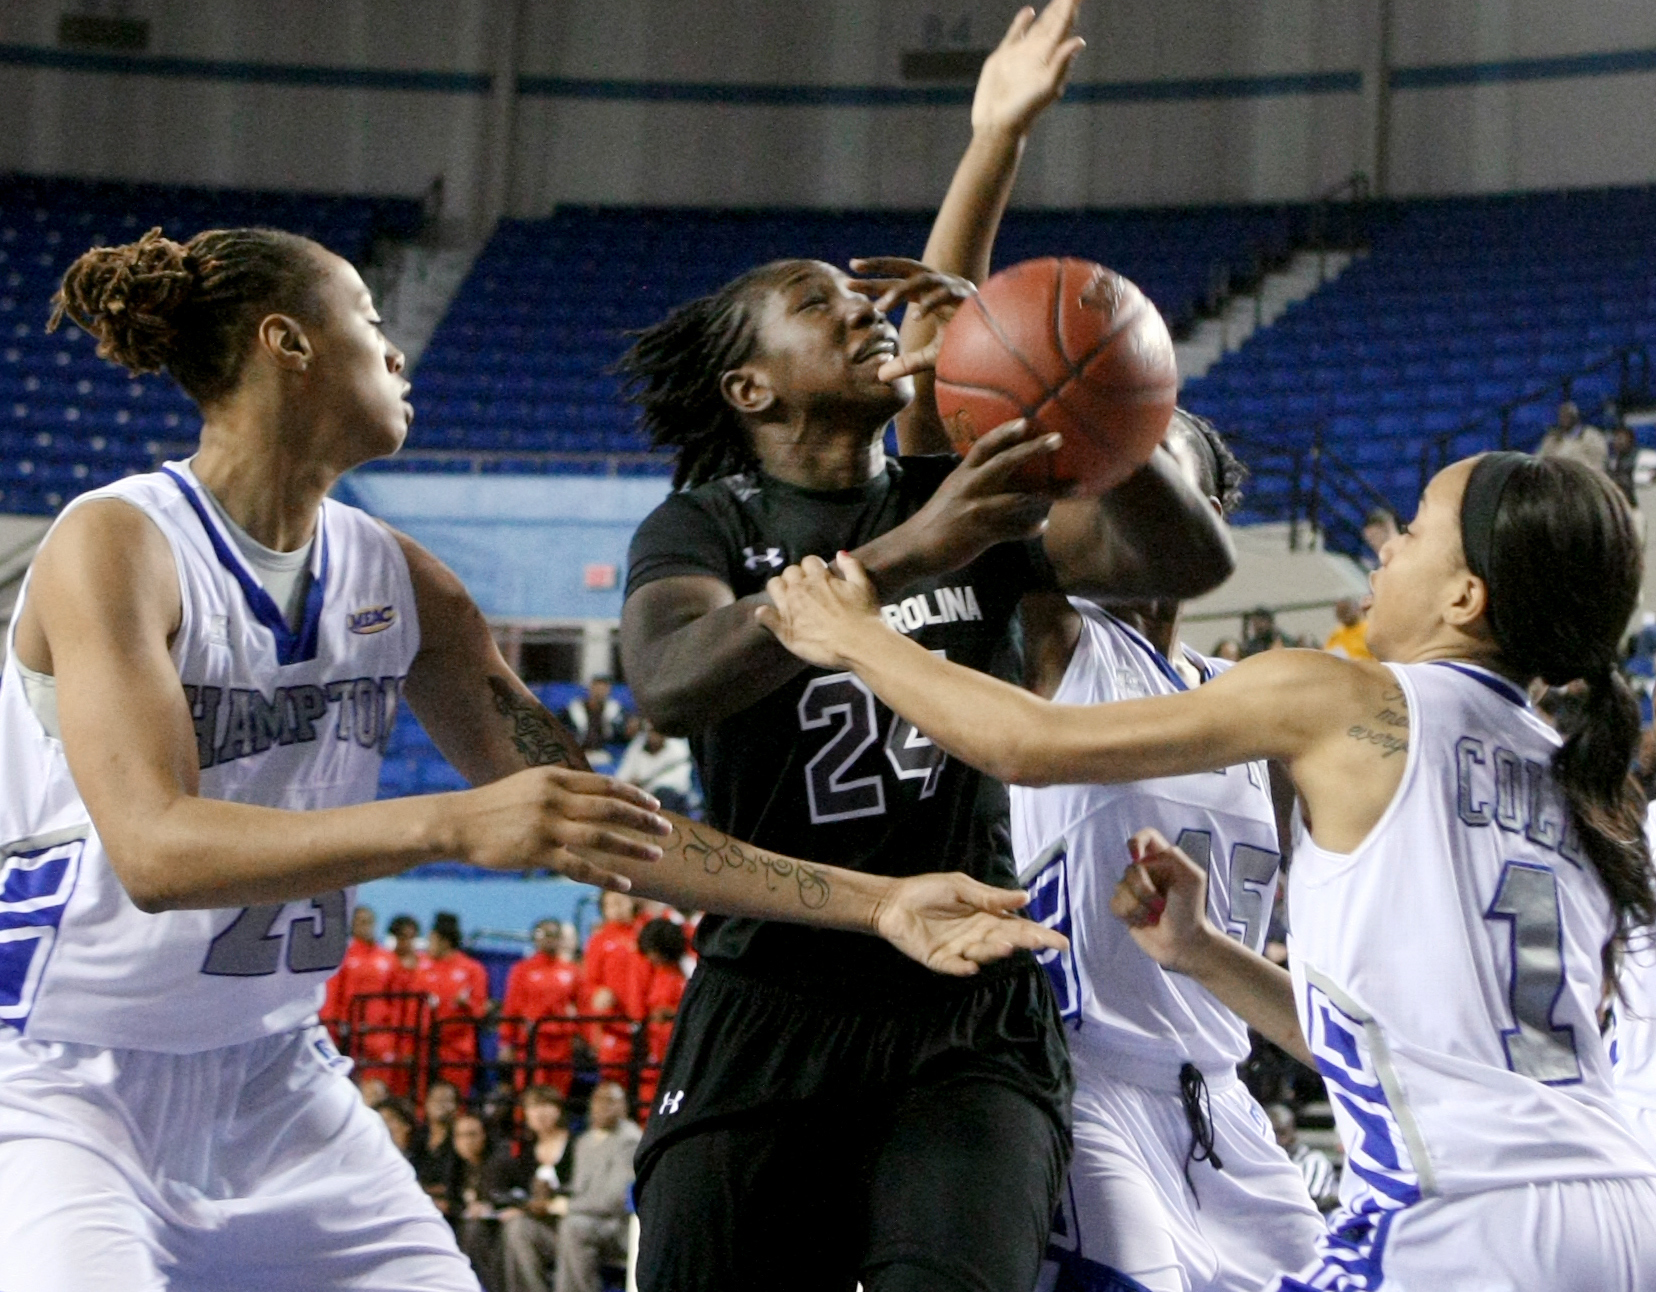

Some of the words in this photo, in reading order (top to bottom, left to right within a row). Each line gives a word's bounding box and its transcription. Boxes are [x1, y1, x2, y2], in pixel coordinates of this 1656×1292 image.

[879, 585, 983, 634] ROLINA
[1455, 735, 1584, 871] COL
[1483, 859, 1584, 1085] 1
